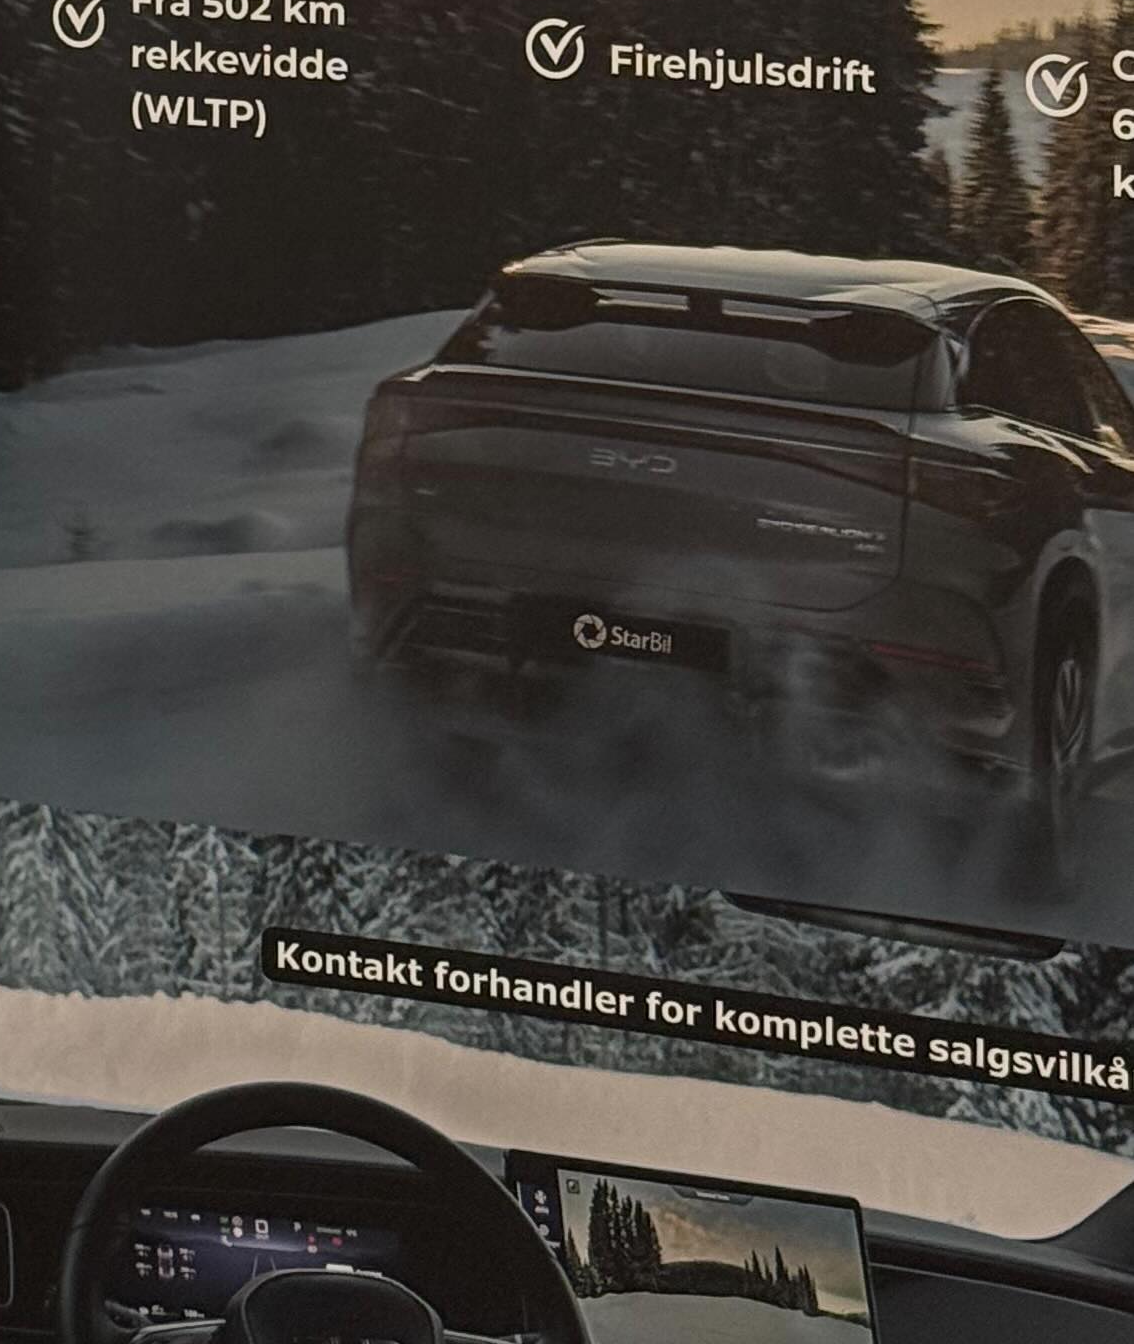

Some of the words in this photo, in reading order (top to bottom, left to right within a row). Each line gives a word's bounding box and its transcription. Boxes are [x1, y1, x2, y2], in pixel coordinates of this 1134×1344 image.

[131, 40, 349, 81] rekkevidde
[610, 43, 877, 94] Firehjulsdrift
[131, 91, 267, 138] (WLTP)
[610, 625, 673, 655] StarBil
[275, 940, 424, 988] Kontakt
[434, 961, 635, 1016] forhandler
[645, 991, 703, 1027] for
[714, 1000, 916, 1059] komplette
[928, 1037, 1131, 1092] salgsvilkå
